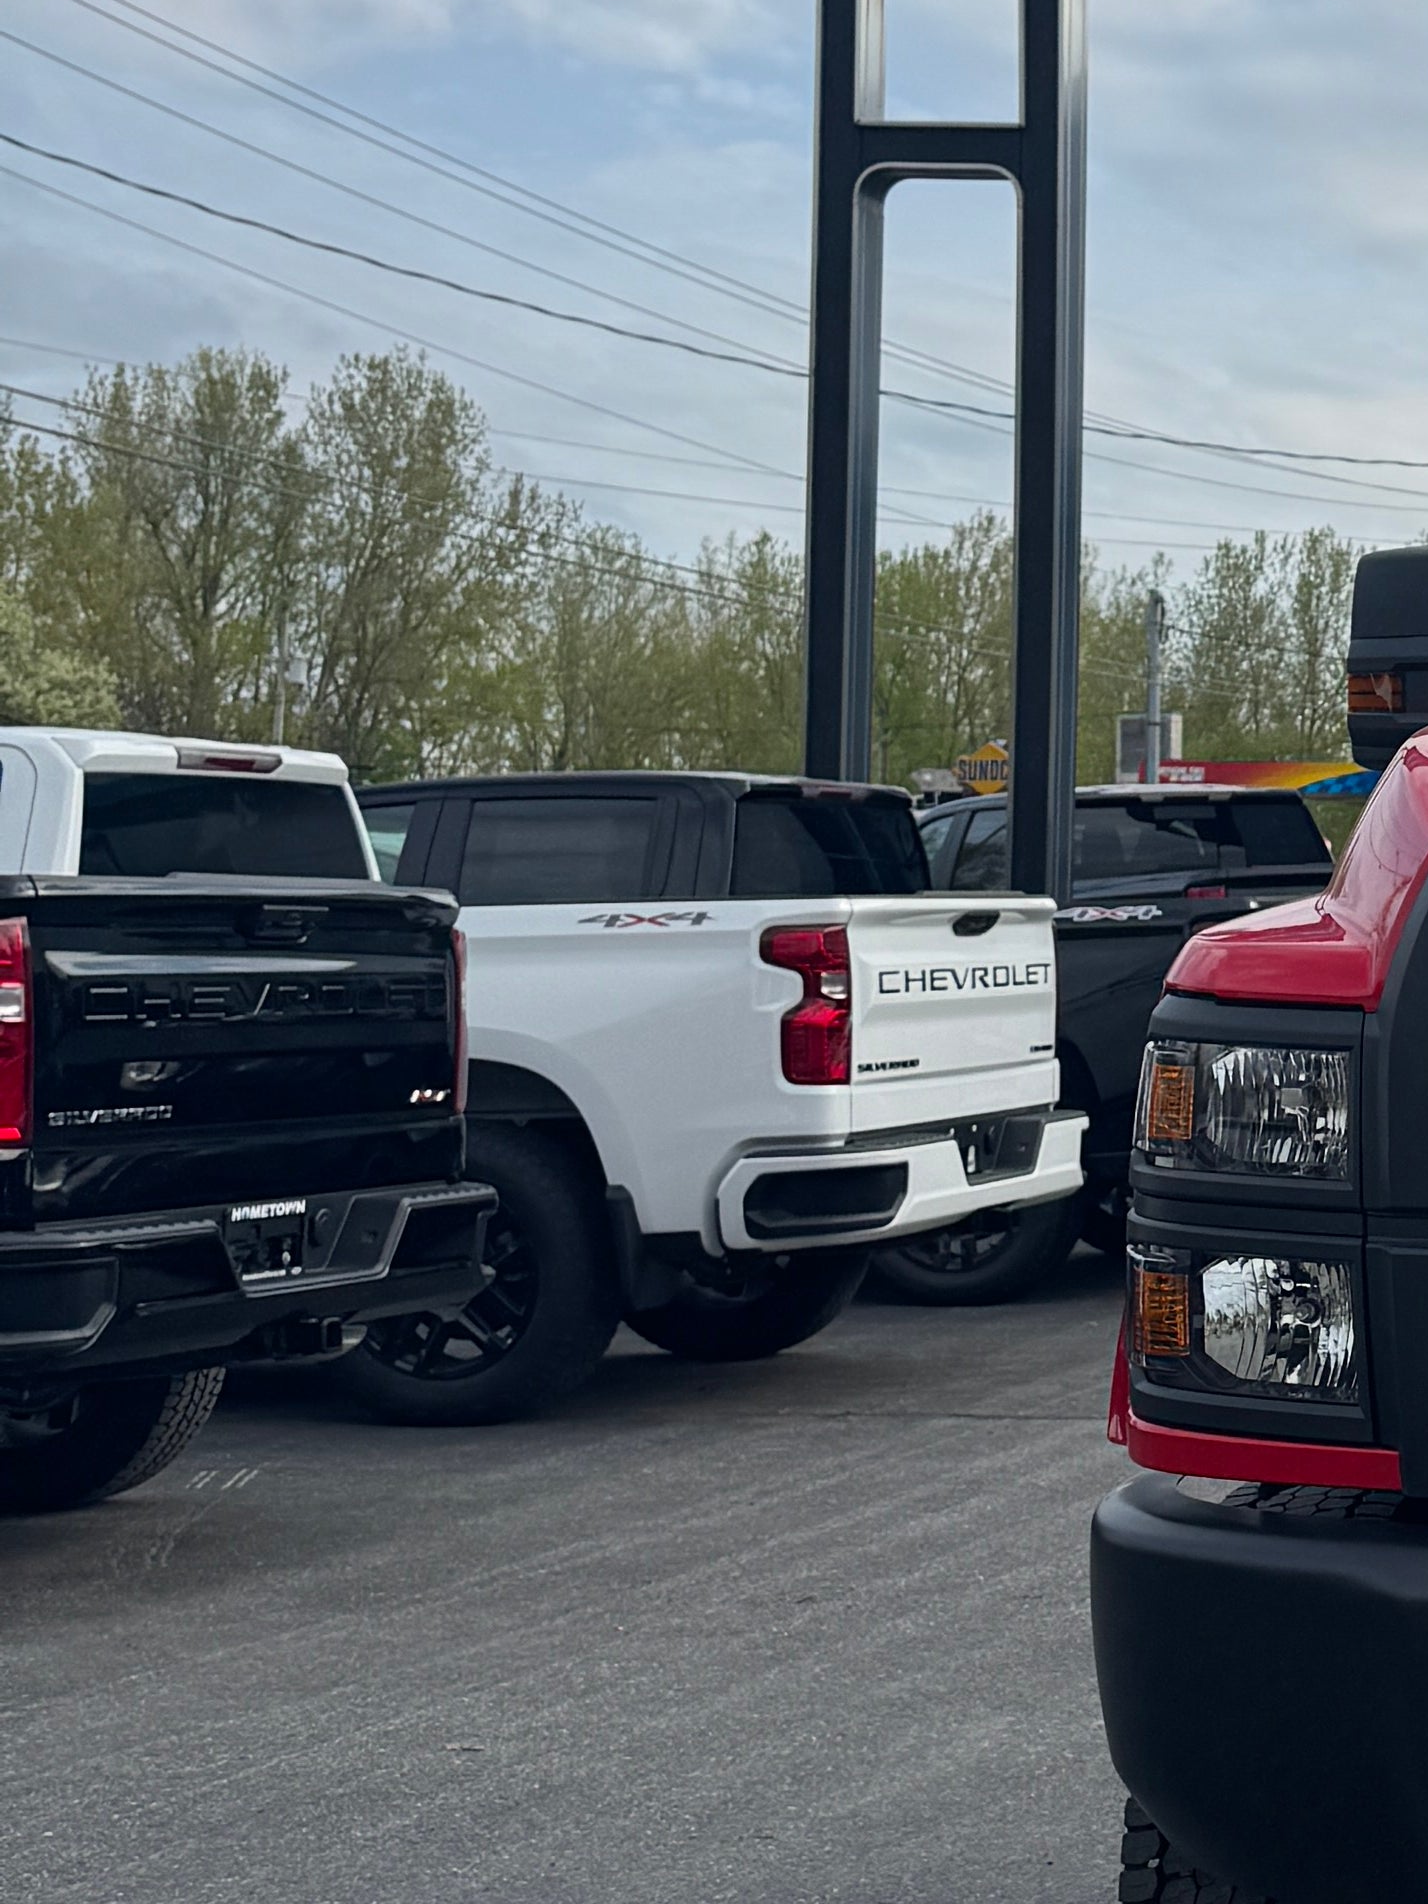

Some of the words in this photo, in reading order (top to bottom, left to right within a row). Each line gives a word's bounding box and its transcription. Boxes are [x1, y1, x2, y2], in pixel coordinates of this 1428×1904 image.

[958, 759, 1009, 781] SUNOC
[878, 963, 1052, 994] CHEVROLET
[82, 980, 448, 1021] CHEVROLET
[230, 1199, 306, 1222] HOMETOWN
